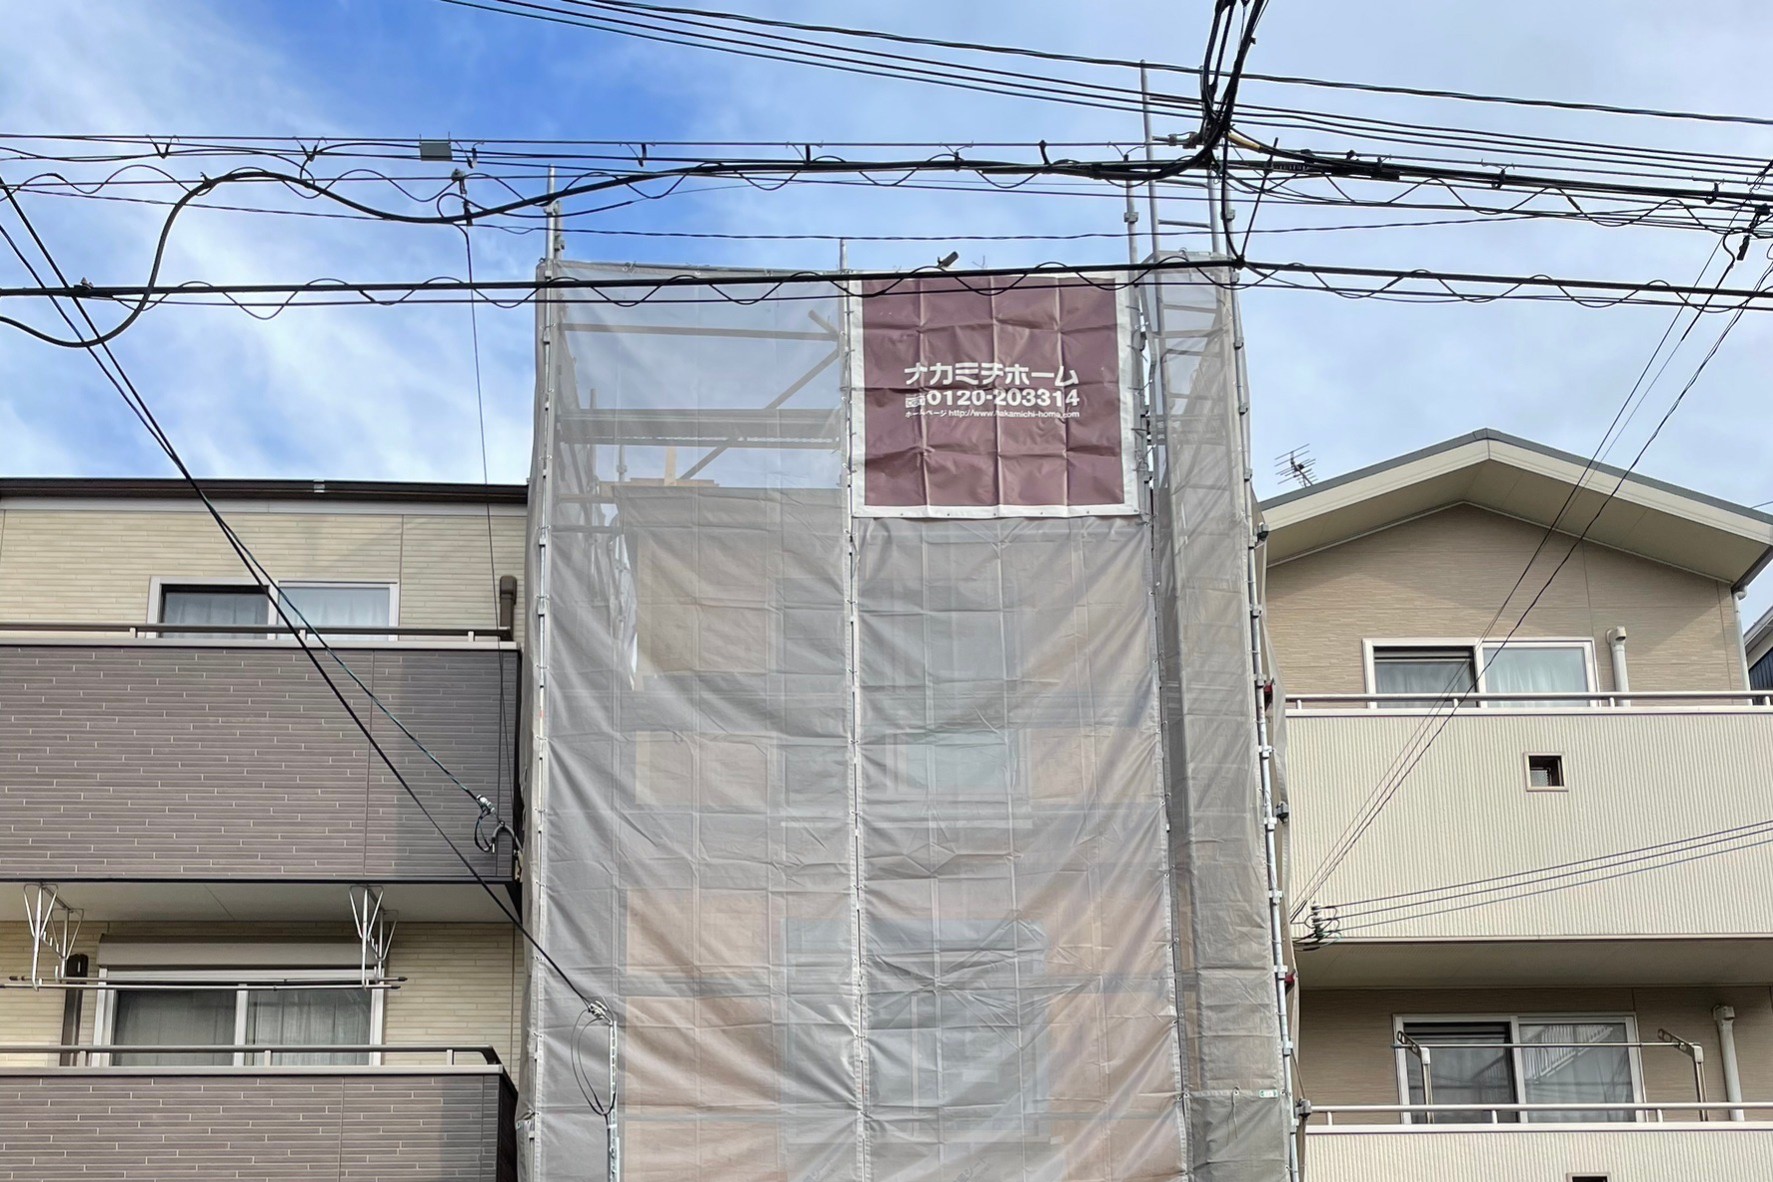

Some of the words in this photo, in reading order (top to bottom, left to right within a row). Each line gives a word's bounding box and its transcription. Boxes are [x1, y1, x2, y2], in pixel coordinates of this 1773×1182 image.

[904, 361, 1079, 387] ナカミチホーム
[926, 388, 1080, 407] 0120-203314
